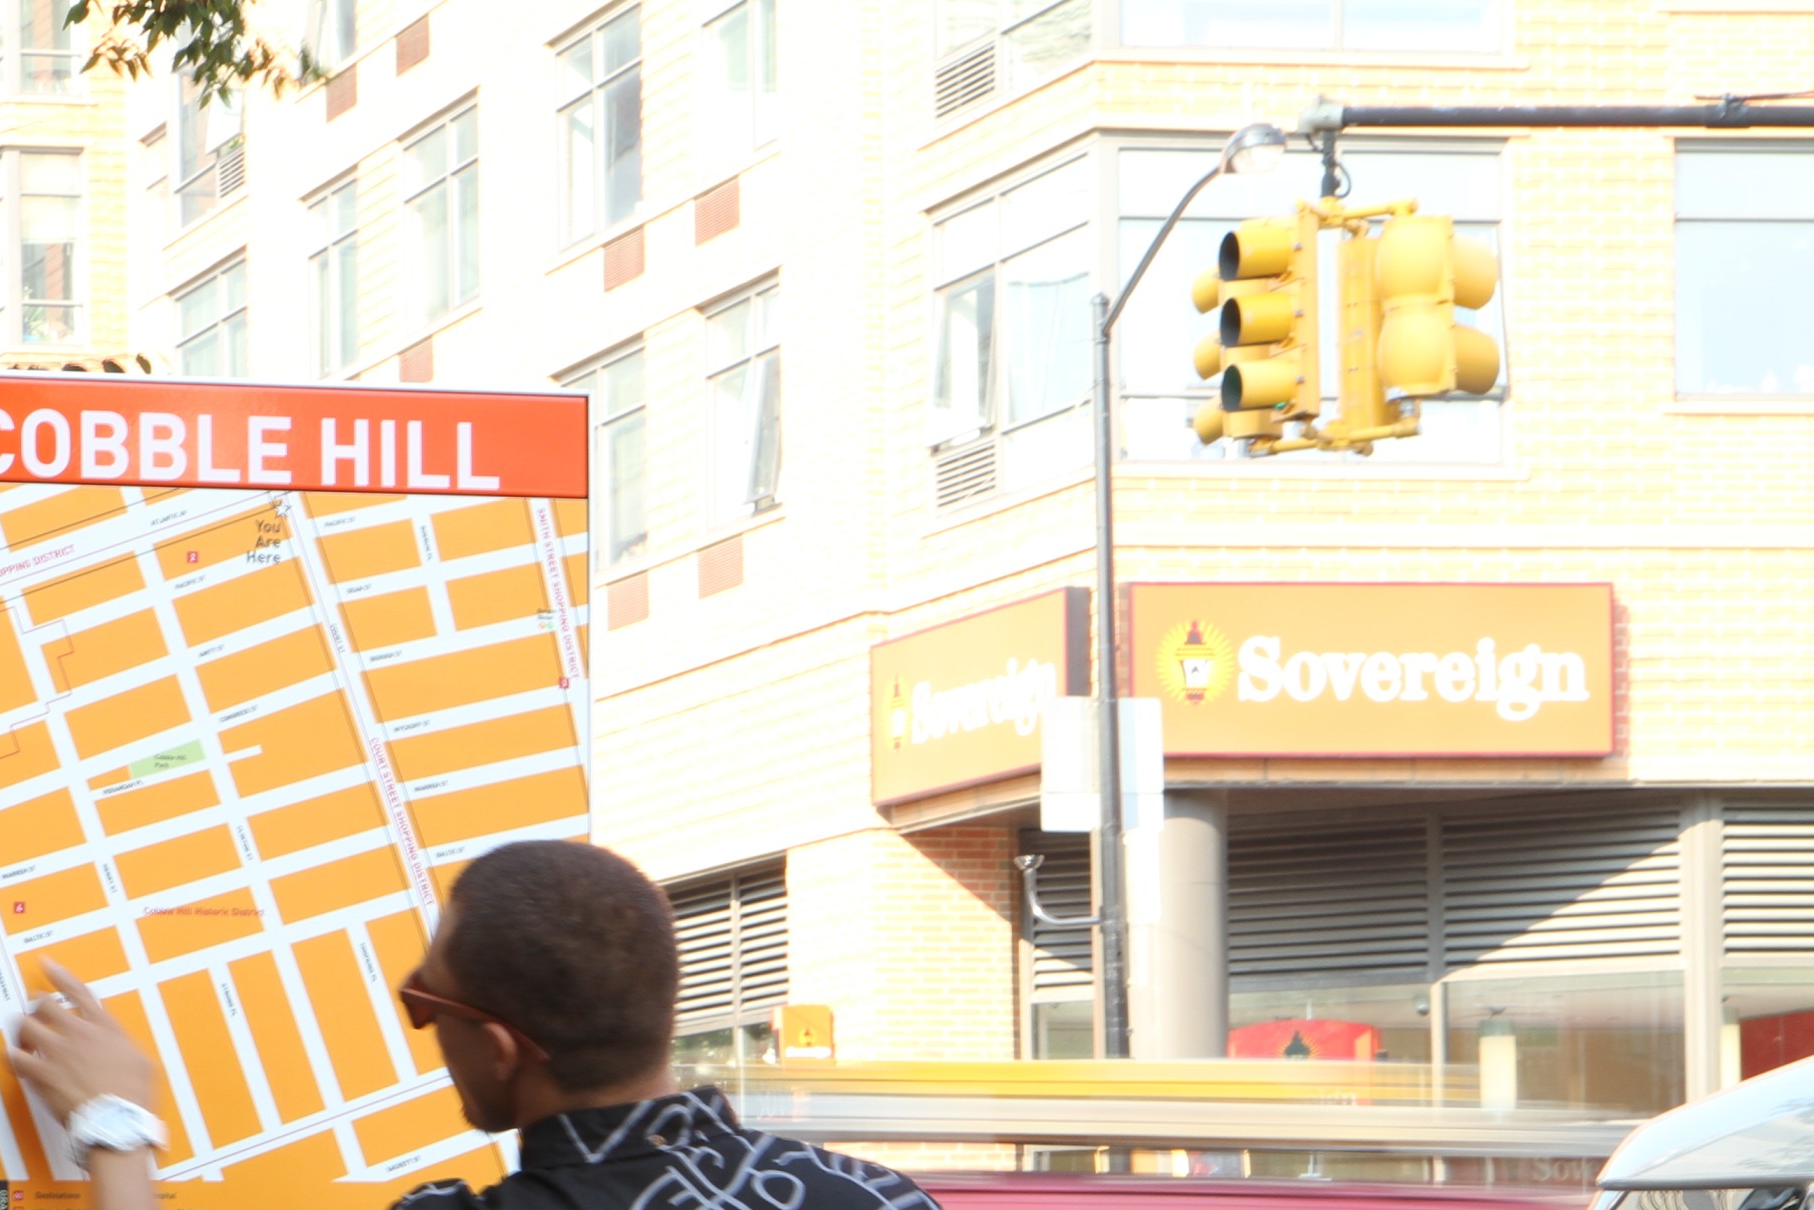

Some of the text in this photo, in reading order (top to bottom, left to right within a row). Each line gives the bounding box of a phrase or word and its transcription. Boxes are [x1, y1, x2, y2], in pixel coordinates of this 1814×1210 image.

[321, 417, 500, 490] HILL
[255, 520, 281, 534] You
[255, 536, 281, 549] Are
[32, 544, 75, 567] DISTRICT
[246, 550, 281, 564] Here
[538, 508, 579, 678] SMITH STREET SHOPPING DISTRICT
[1238, 636, 1590, 722] Sovereign
[370, 737, 434, 905] COURT STREET SHOPPING DISTRICT
